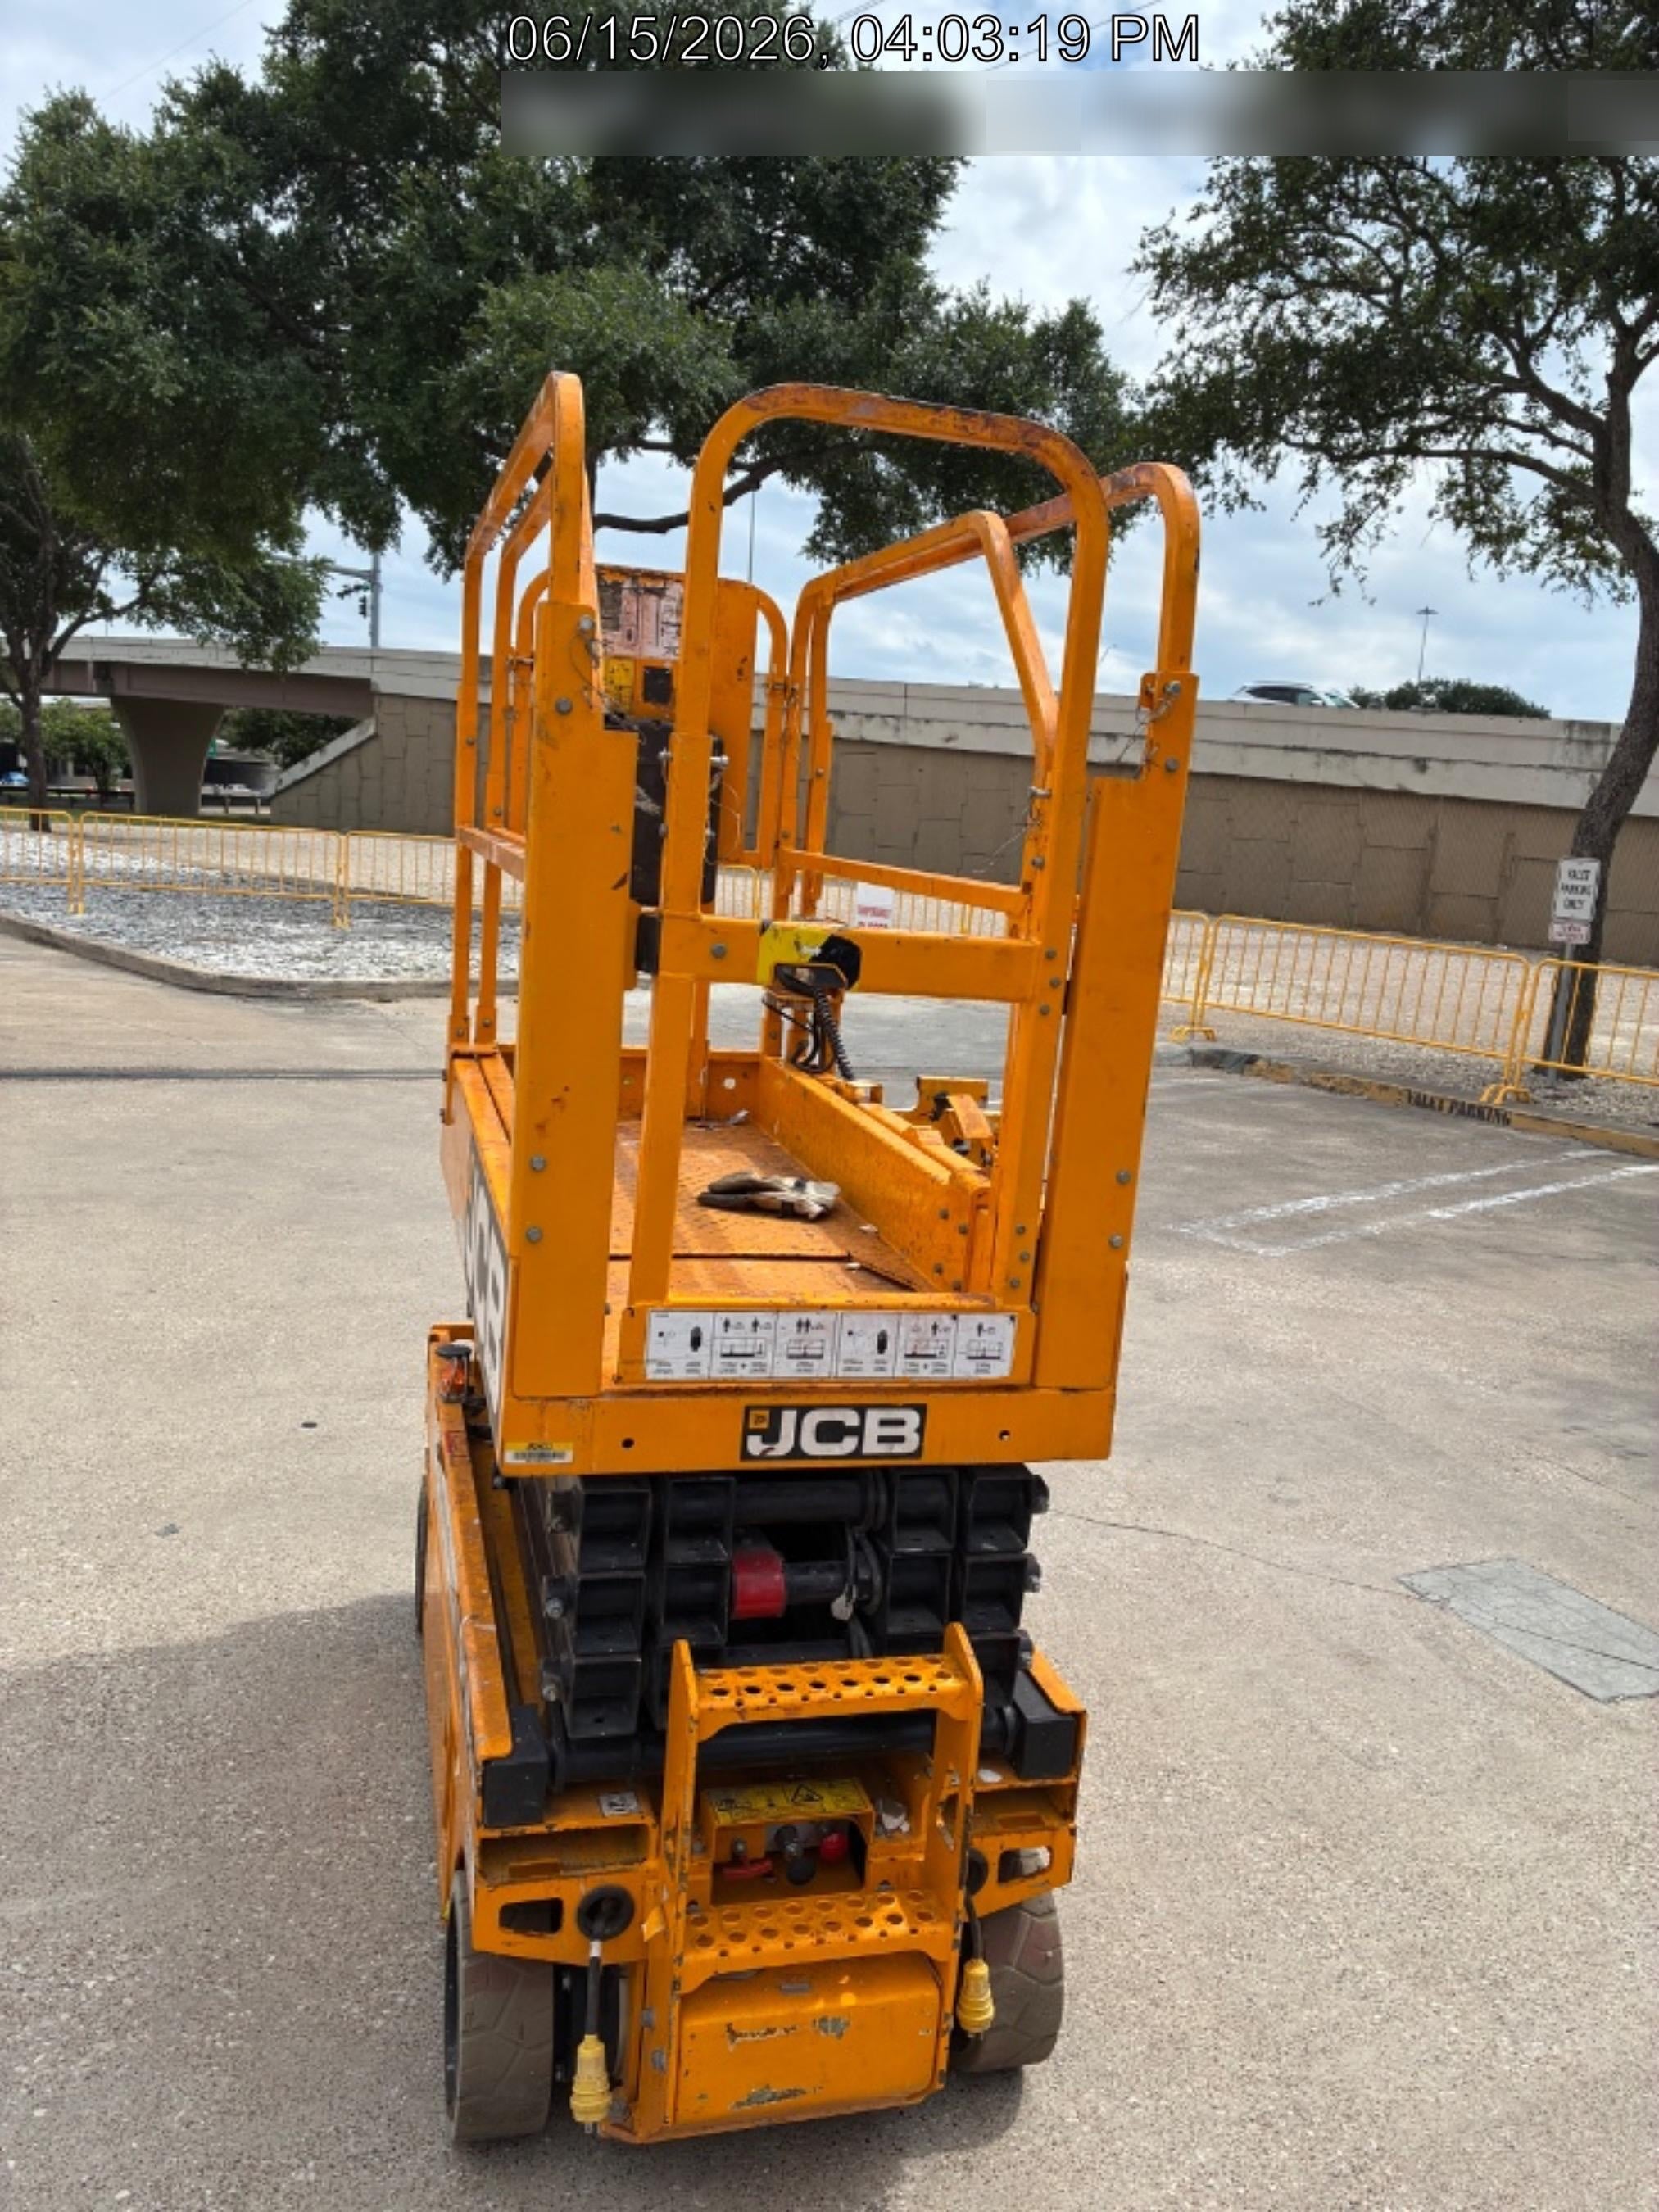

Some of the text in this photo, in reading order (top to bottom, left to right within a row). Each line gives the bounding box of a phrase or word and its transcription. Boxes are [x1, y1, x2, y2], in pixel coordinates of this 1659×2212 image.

[1561, 883, 1591, 895] PARKING
[1563, 898, 1585, 909] ONLY
[746, 1407, 921, 1457] JCB
